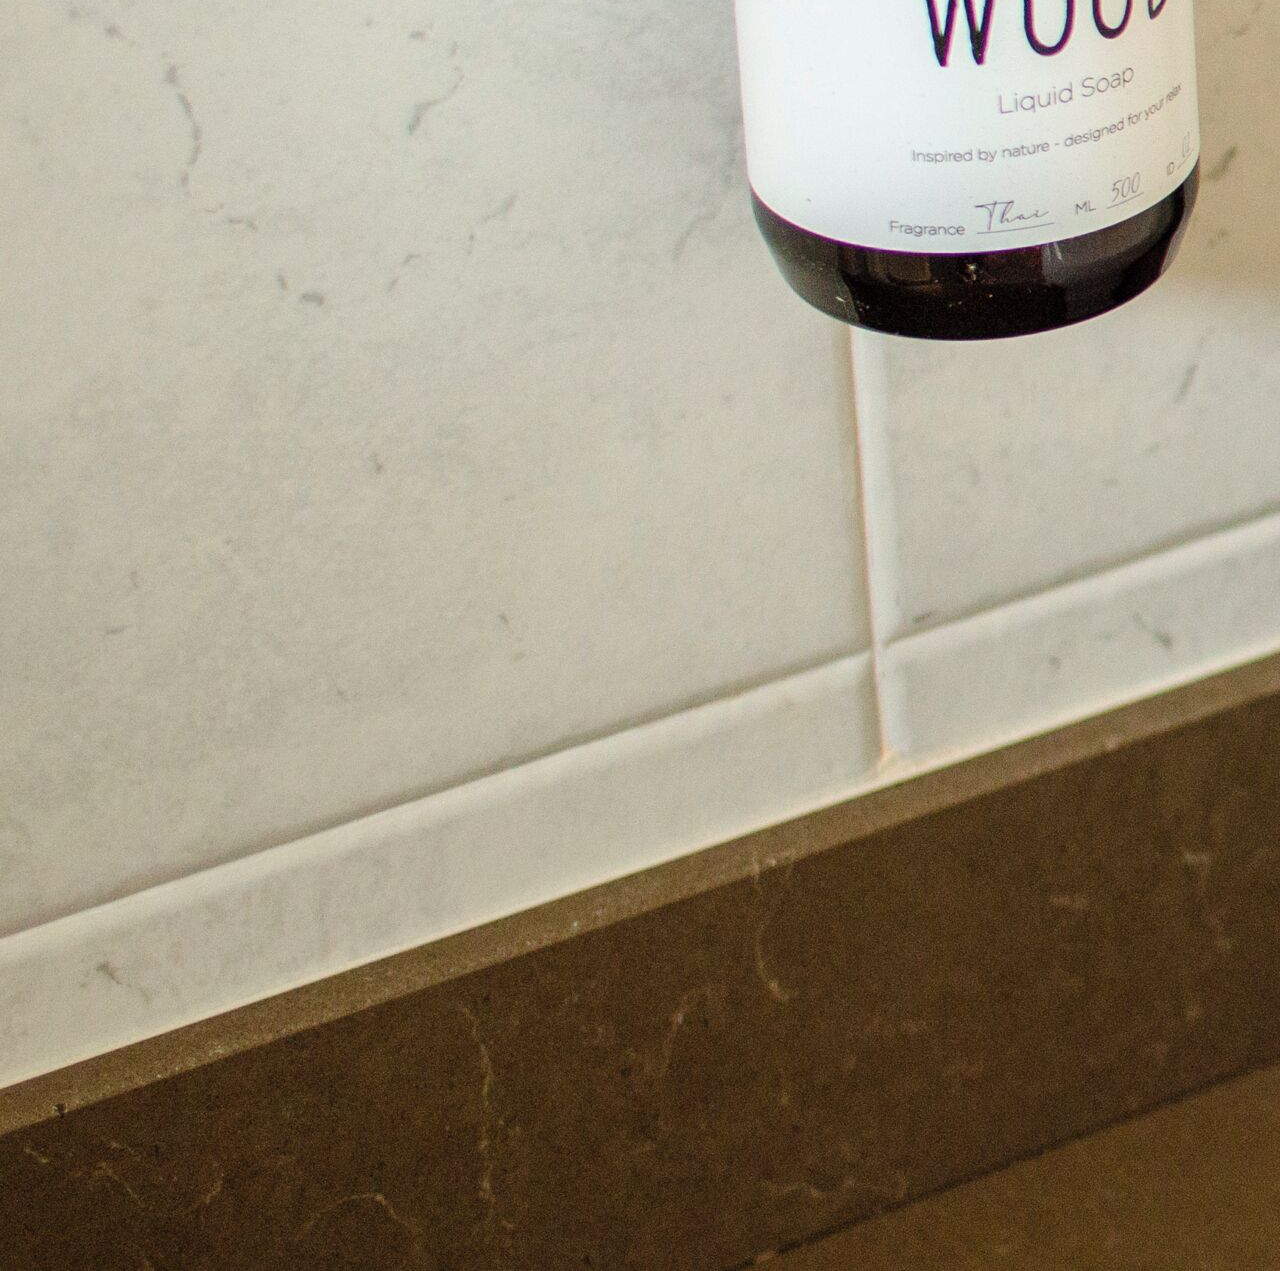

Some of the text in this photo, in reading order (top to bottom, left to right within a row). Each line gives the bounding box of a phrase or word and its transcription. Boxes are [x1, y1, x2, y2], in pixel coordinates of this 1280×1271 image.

[998, 66, 1135, 114] Liquid Soap
[912, 148, 973, 165] Inspired
[978, 148, 998, 163] by
[1001, 140, 1050, 158] nature
[1064, 118, 1125, 148] designed
[1127, 112, 1143, 126] for
[1143, 97, 1165, 121] your
[889, 219, 966, 237] Fragrance
[1074, 201, 1097, 216] ML
[1111, 171, 1142, 203] 500
